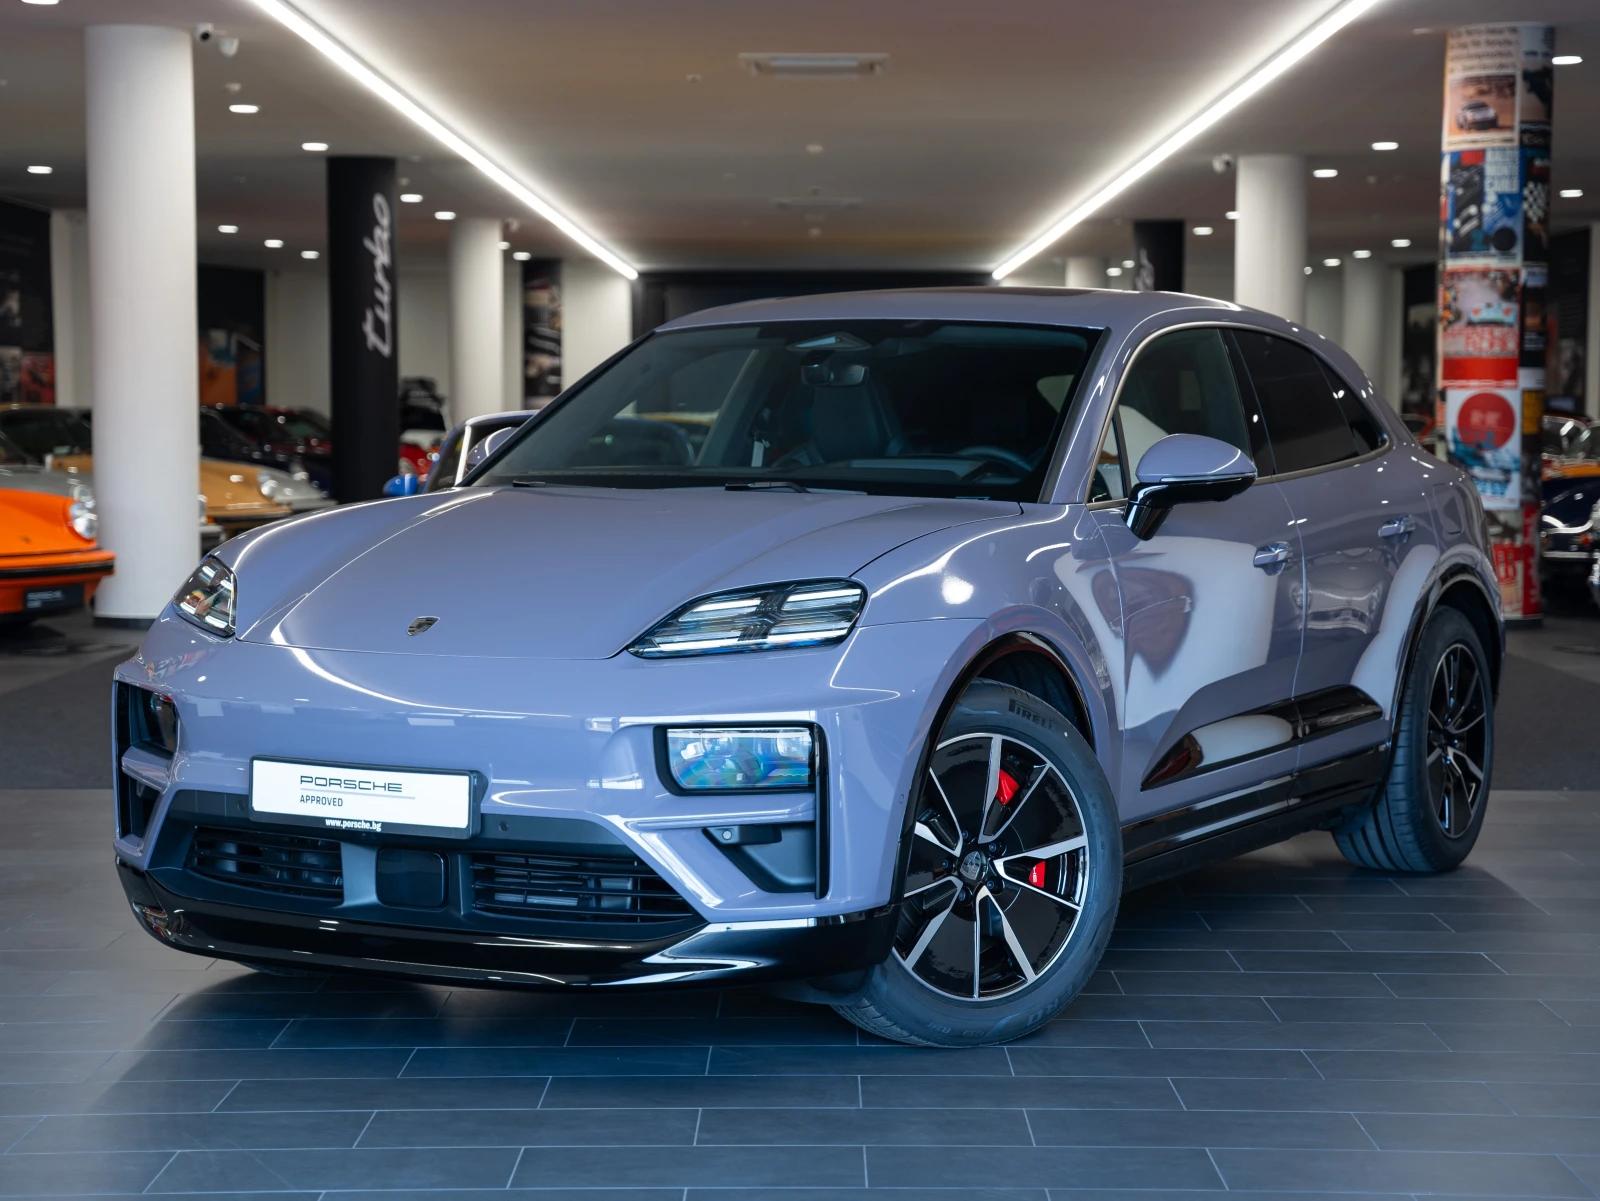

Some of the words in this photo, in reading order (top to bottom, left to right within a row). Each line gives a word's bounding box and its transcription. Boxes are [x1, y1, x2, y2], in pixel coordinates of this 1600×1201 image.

[362, 192, 392, 357] turbo
[300, 775, 403, 793] PORSCHE
[299, 794, 344, 807] APPROVED
[325, 818, 382, 832] www.porsche.bg
